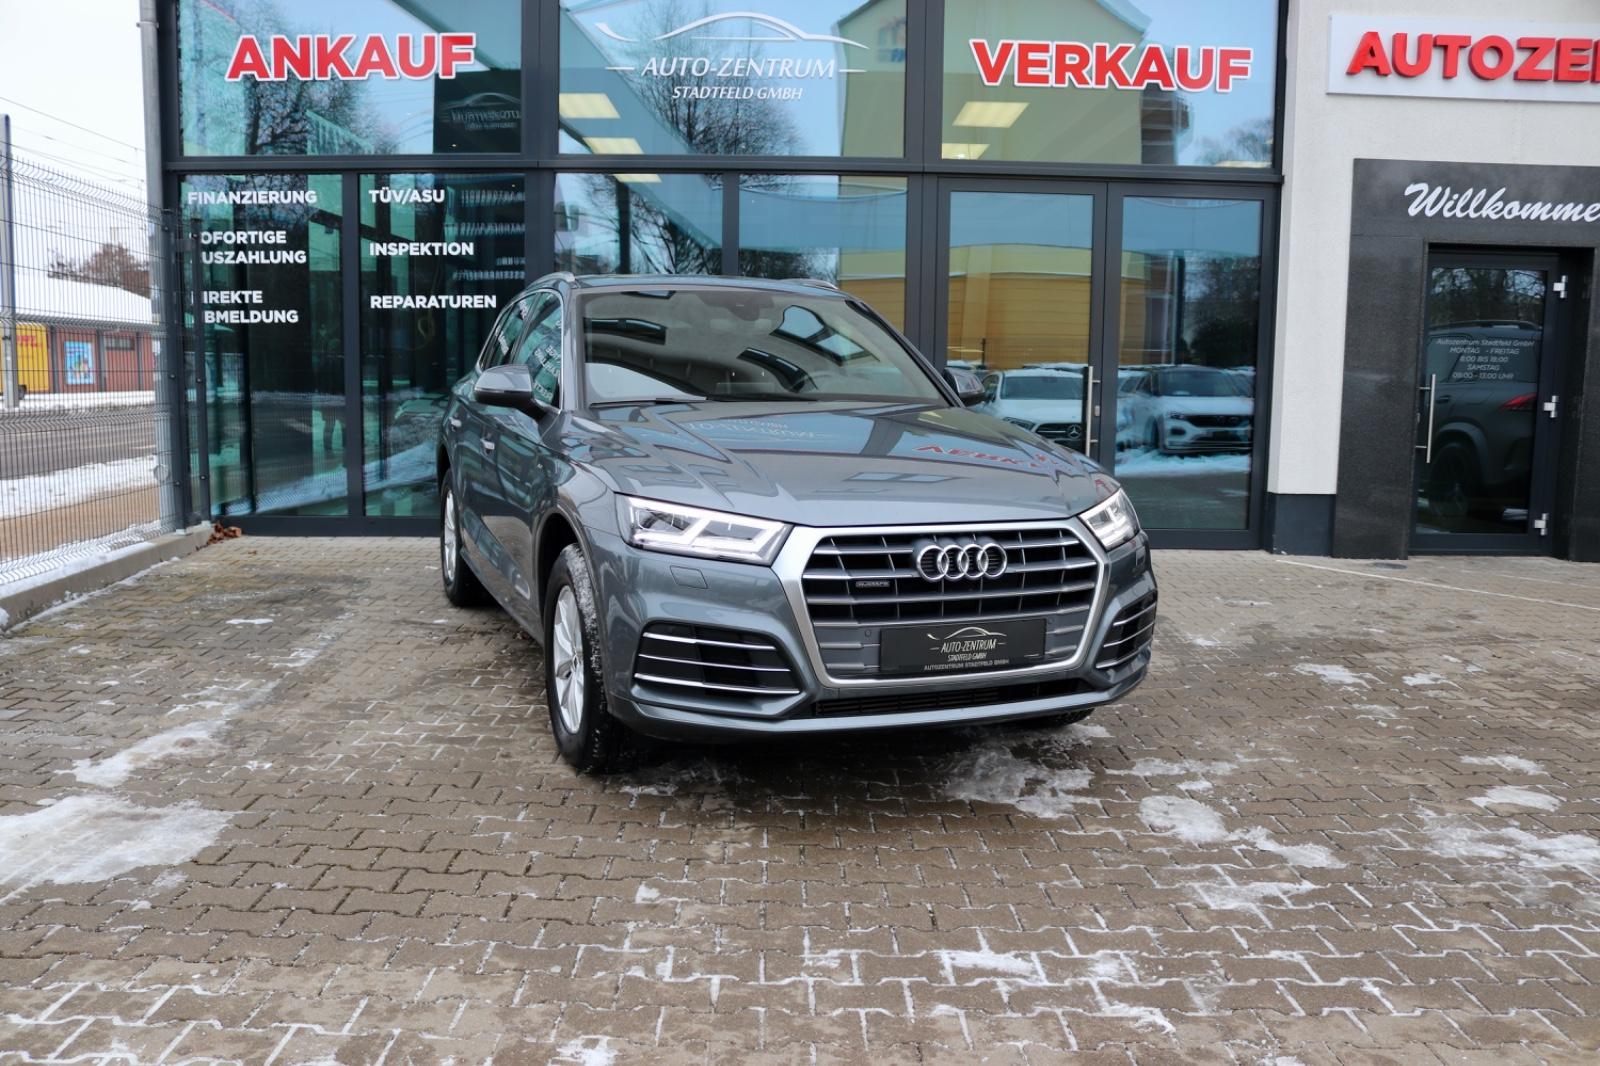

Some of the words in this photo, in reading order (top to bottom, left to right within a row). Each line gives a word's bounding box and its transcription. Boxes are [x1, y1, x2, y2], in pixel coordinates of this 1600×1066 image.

[225, 32, 476, 82] ANKAUF
[641, 56, 836, 78] AUTO-ZENTRUM
[969, 39, 1253, 92] VERKAUF
[672, 85, 754, 100] STADTFELD
[757, 87, 804, 101] GMBH
[187, 190, 318, 205] FINANZIERUNG
[368, 186, 445, 205] TÜV/ASU
[189, 230, 287, 245] OFORTIGE
[369, 242, 474, 256] INSPEKTION
[190, 250, 307, 264] USZAHLUNG
[191, 290, 263, 304] IREKTE
[370, 295, 497, 309] REPARATUREN
[192, 310, 299, 324] BMELDUNG
[941, 638, 997, 654] AUTO-ZENTRUM
